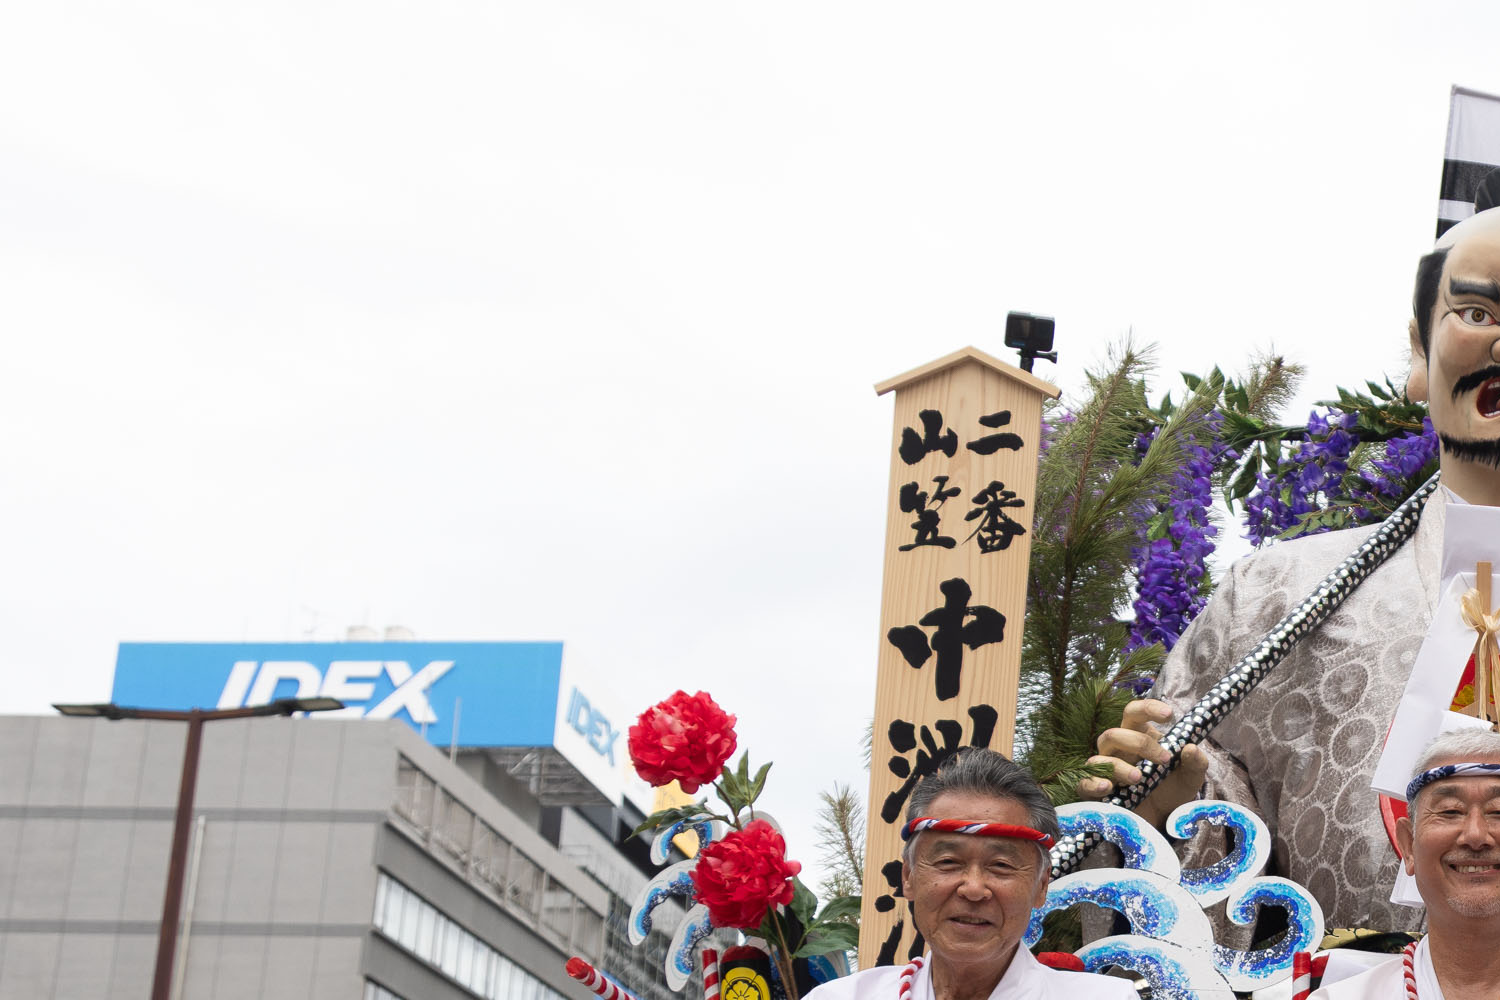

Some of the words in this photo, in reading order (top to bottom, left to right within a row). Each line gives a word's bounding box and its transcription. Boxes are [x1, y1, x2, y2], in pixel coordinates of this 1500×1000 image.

[898, 408, 961, 553] 山笠
[963, 409, 1026, 554] 二番
[216, 660, 455, 724] IDEX
[566, 686, 620, 767] IDEX
